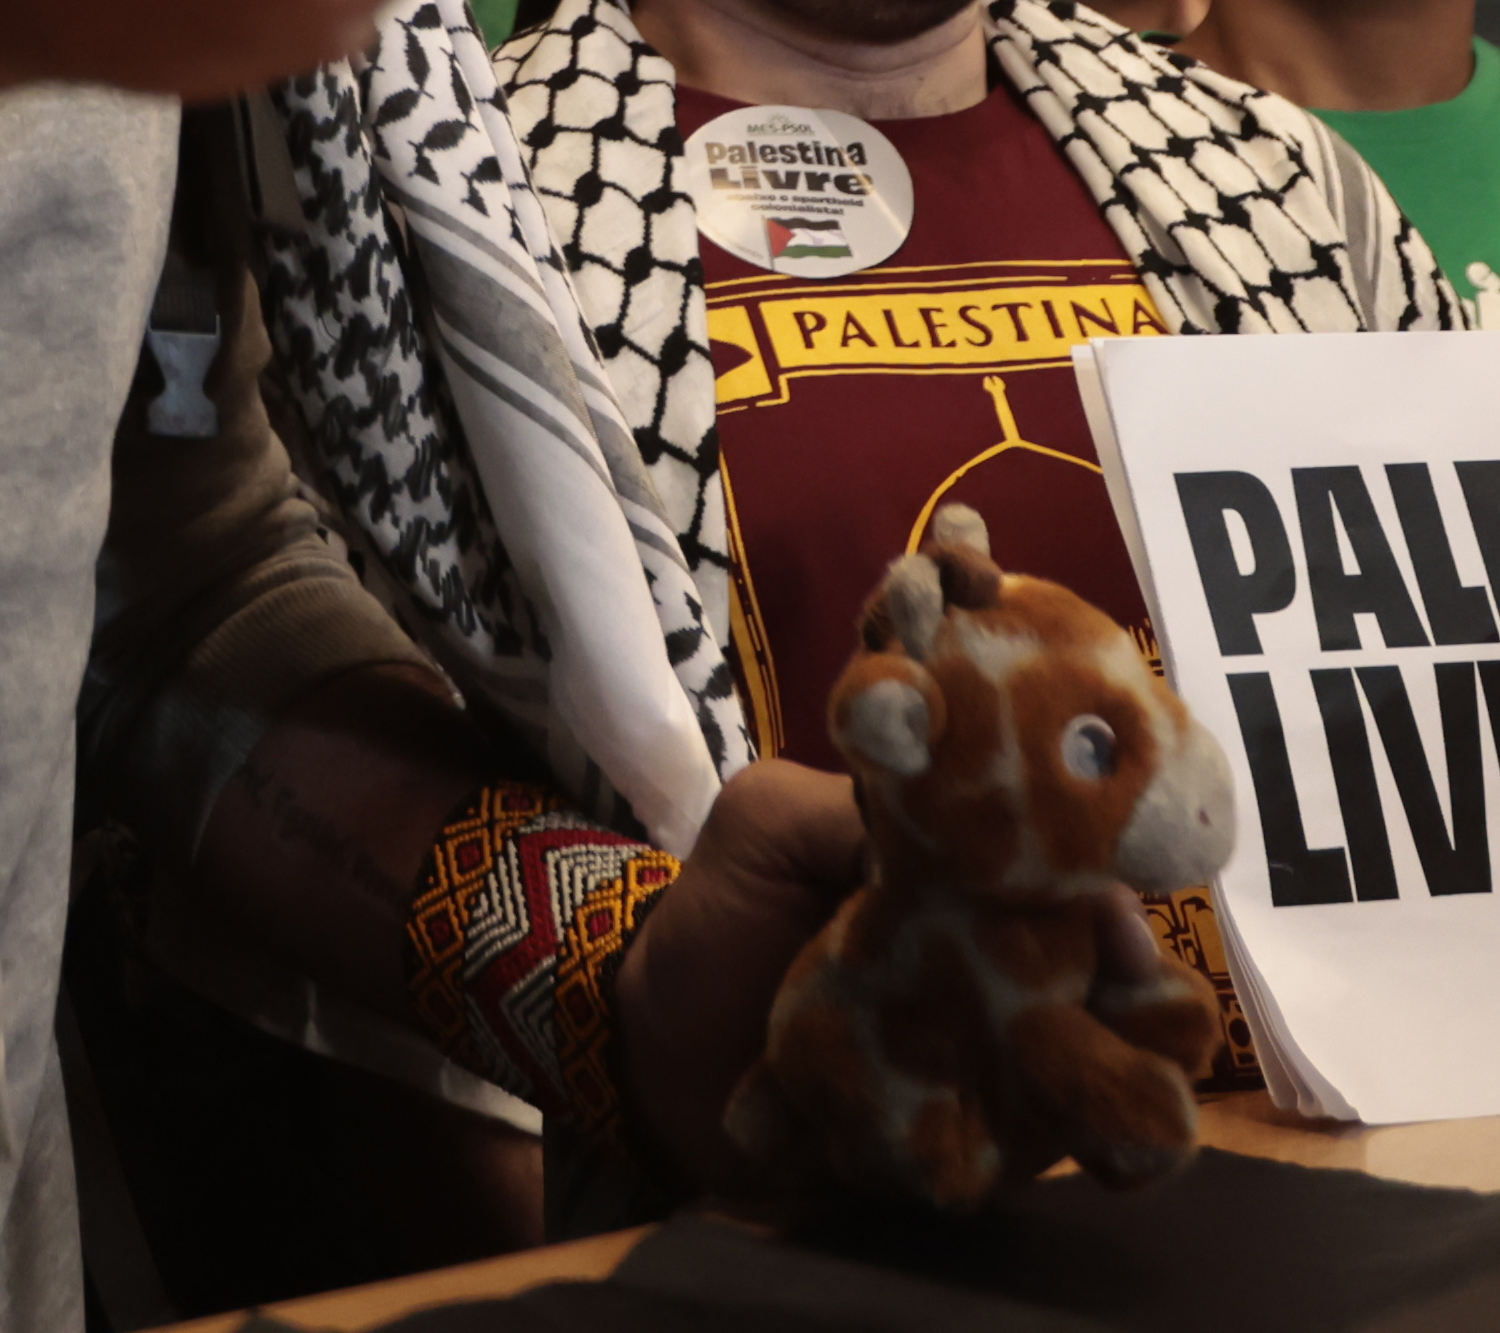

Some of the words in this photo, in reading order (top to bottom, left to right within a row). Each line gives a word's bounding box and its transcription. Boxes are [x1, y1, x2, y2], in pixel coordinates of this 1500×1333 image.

[705, 141, 867, 166] Palestina
[710, 167, 873, 195] Livre
[793, 298, 1170, 349] PALESTINA
